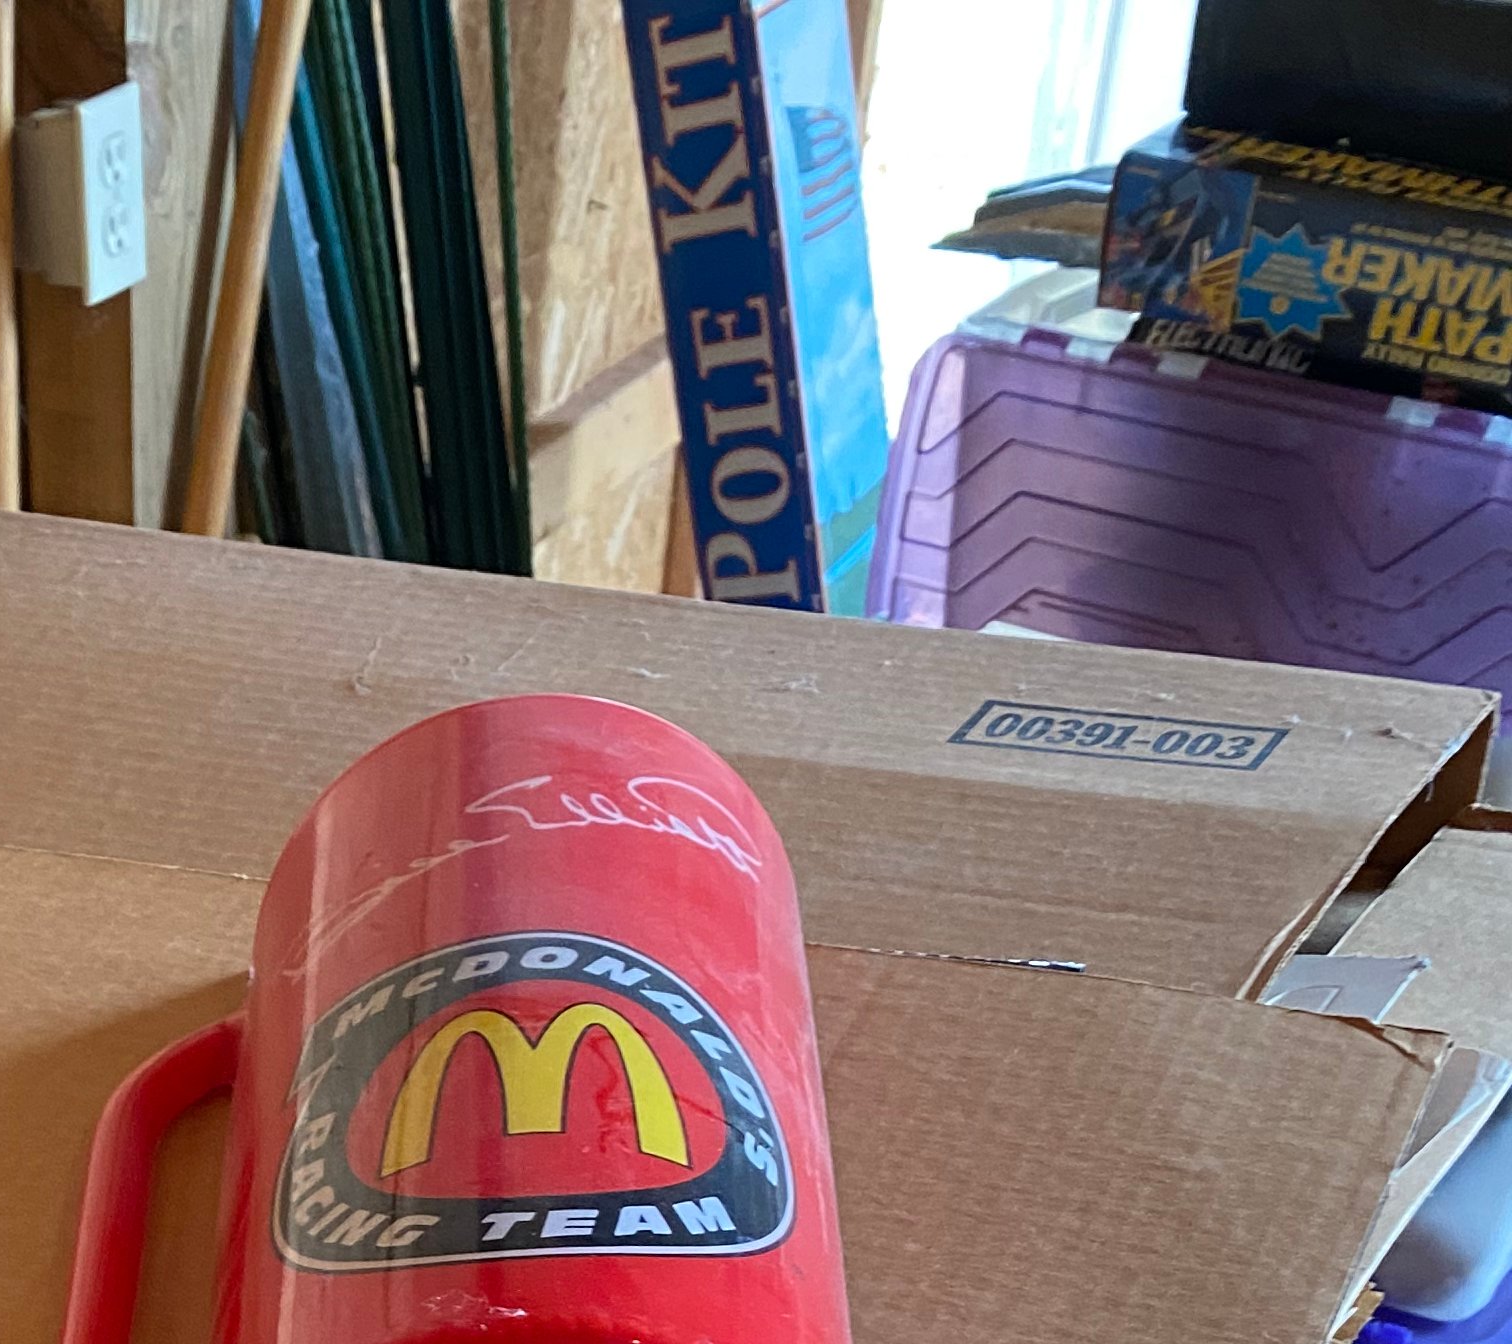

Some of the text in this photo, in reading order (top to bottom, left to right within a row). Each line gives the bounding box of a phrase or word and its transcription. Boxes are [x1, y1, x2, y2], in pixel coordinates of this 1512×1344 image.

[648, 14, 802, 602] POLE KIT
[1368, 297, 1512, 366] PATH
[984, 711, 1256, 761] 00391-003
[290, 1112, 737, 1248] RACING TEAM
